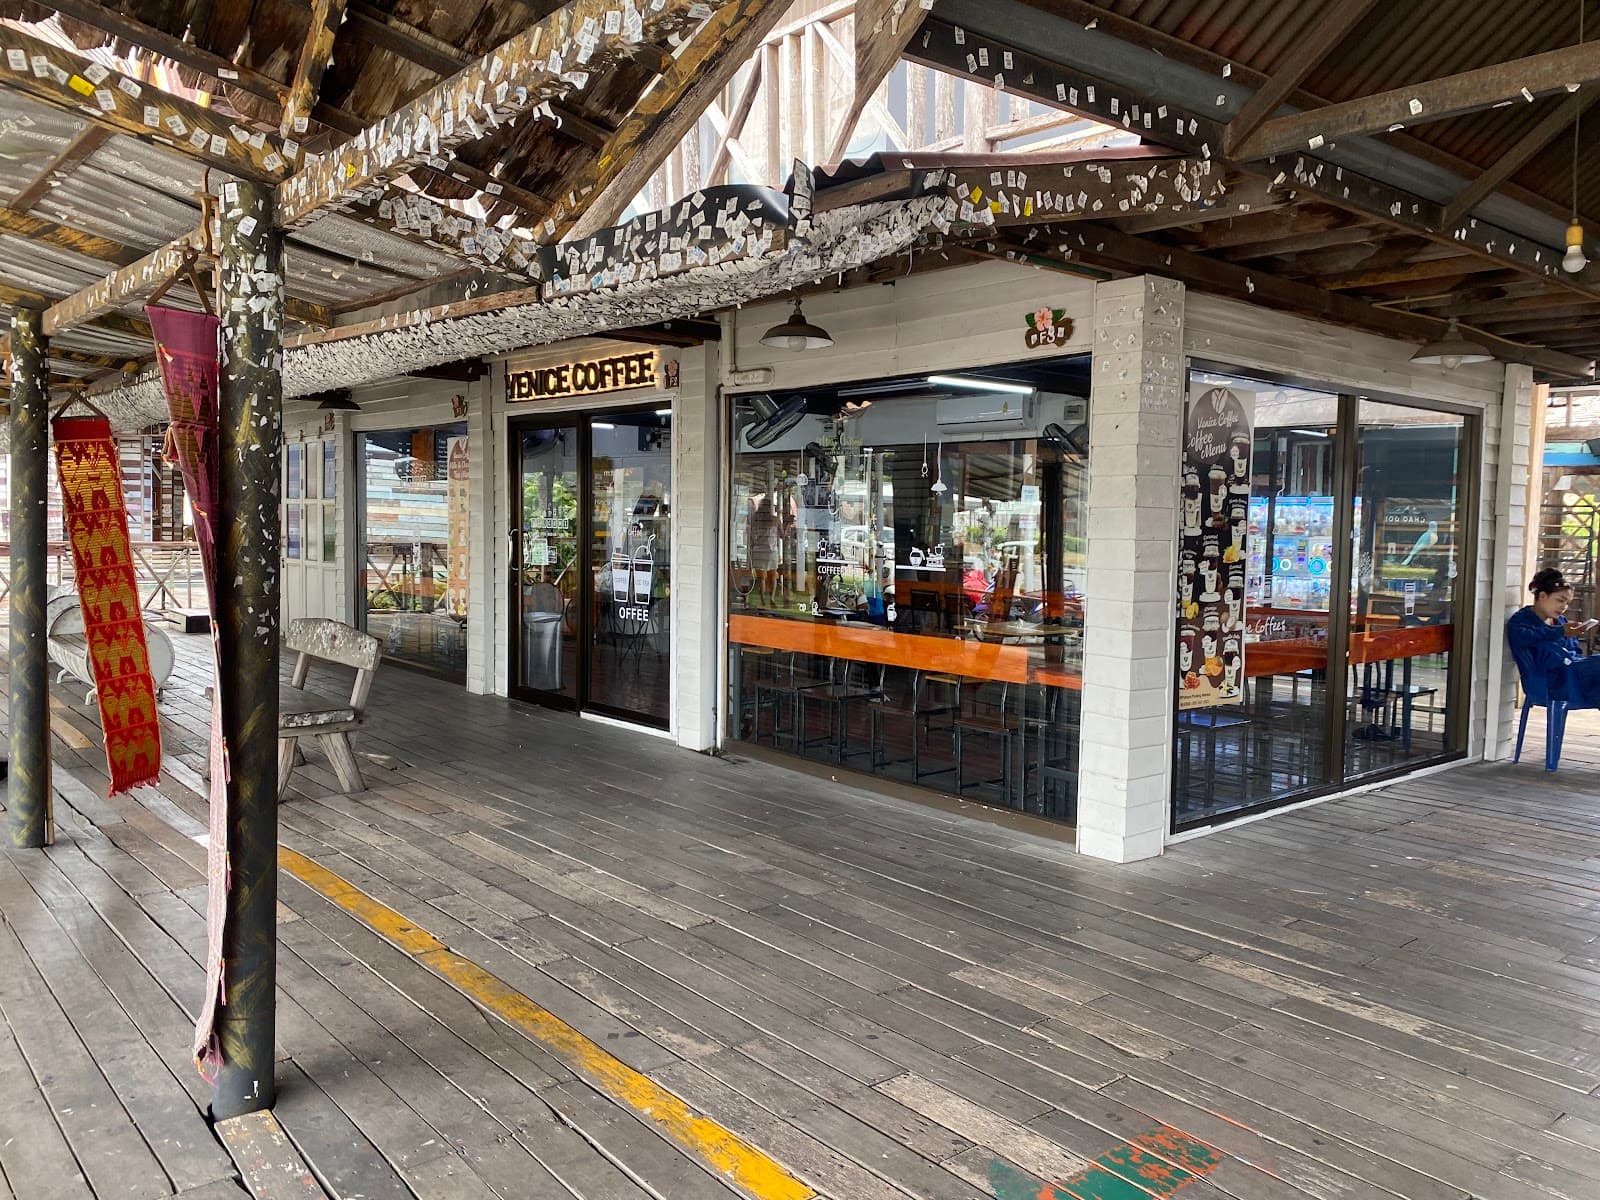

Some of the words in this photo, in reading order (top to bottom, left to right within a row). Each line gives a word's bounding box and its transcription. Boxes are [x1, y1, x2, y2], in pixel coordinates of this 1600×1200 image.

[504, 365, 570, 399] VENICE
[572, 351, 655, 391] COFFEE
[1197, 415, 1218, 429] Venice
